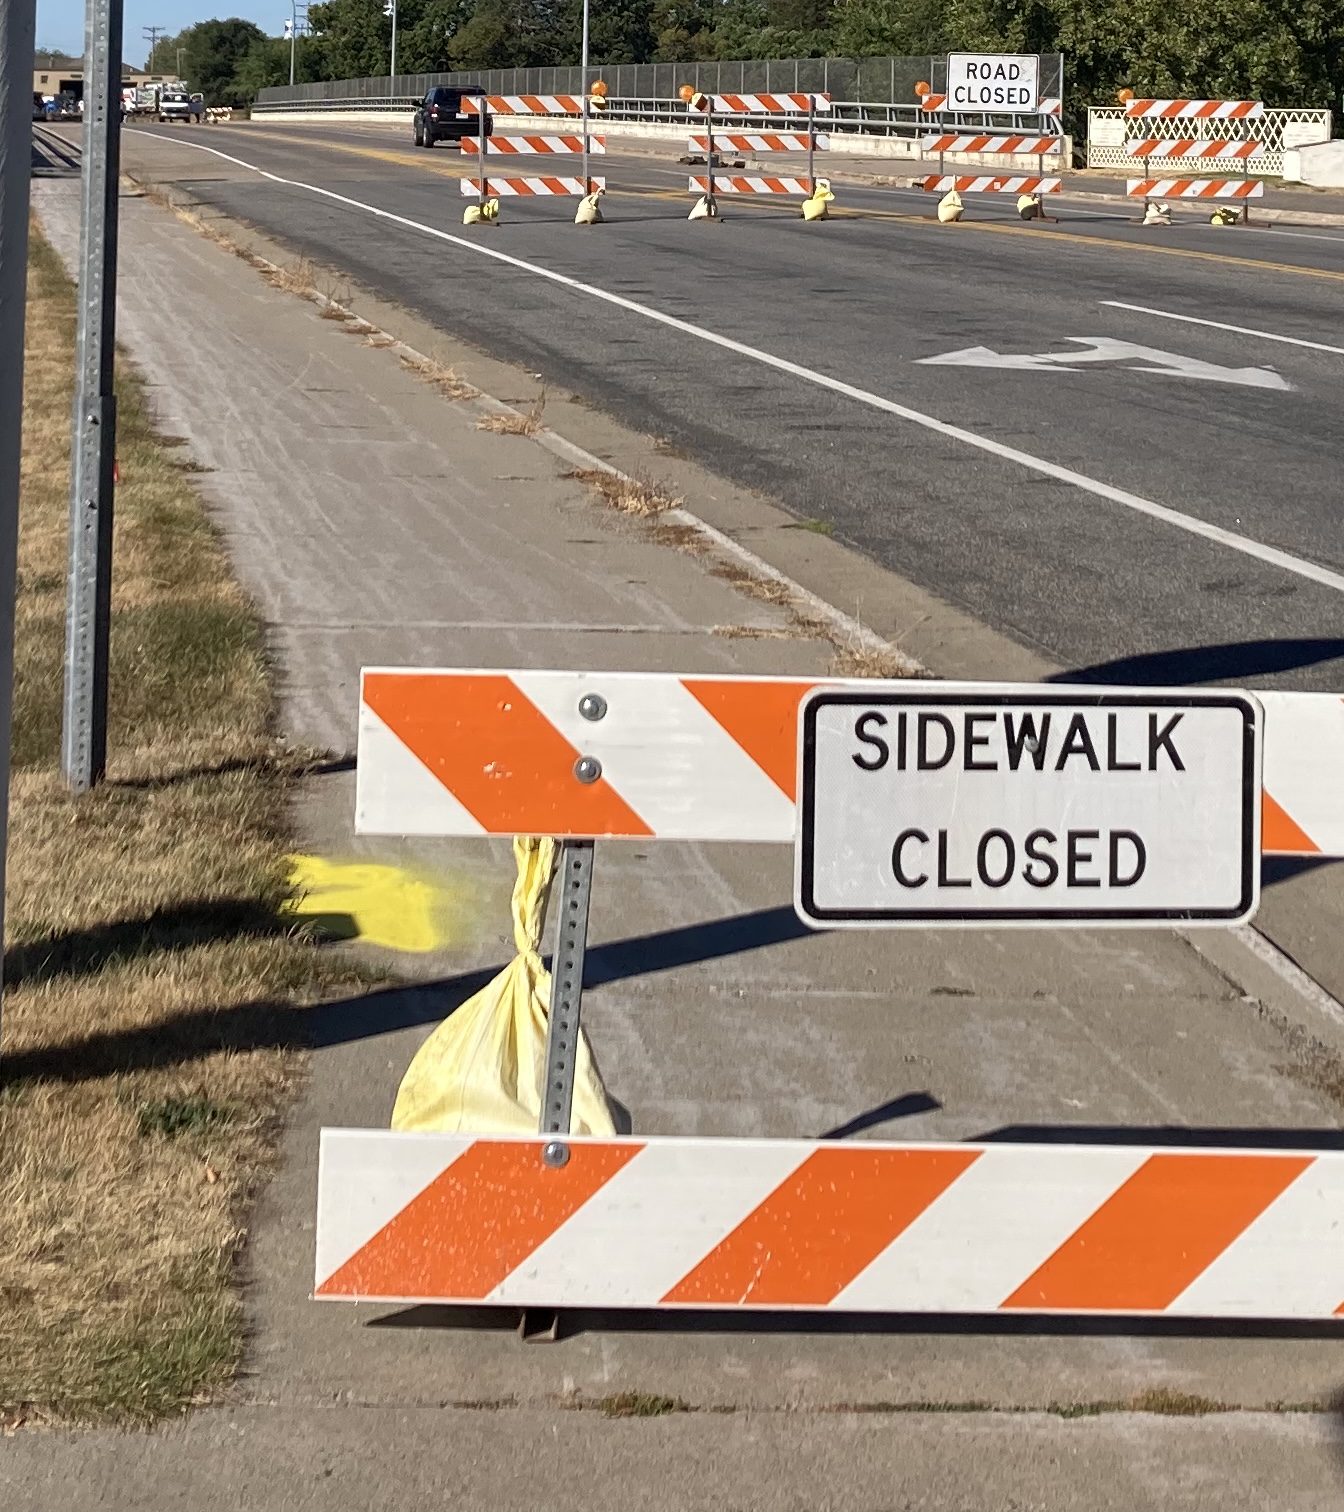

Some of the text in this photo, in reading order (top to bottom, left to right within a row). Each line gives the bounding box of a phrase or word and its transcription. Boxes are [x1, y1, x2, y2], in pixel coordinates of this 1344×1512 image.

[967, 62, 1020, 80] ROAD
[954, 86, 1031, 104] CLOSED
[851, 711, 1186, 772] SIDEWALK
[891, 827, 1147, 888] CLOSED
